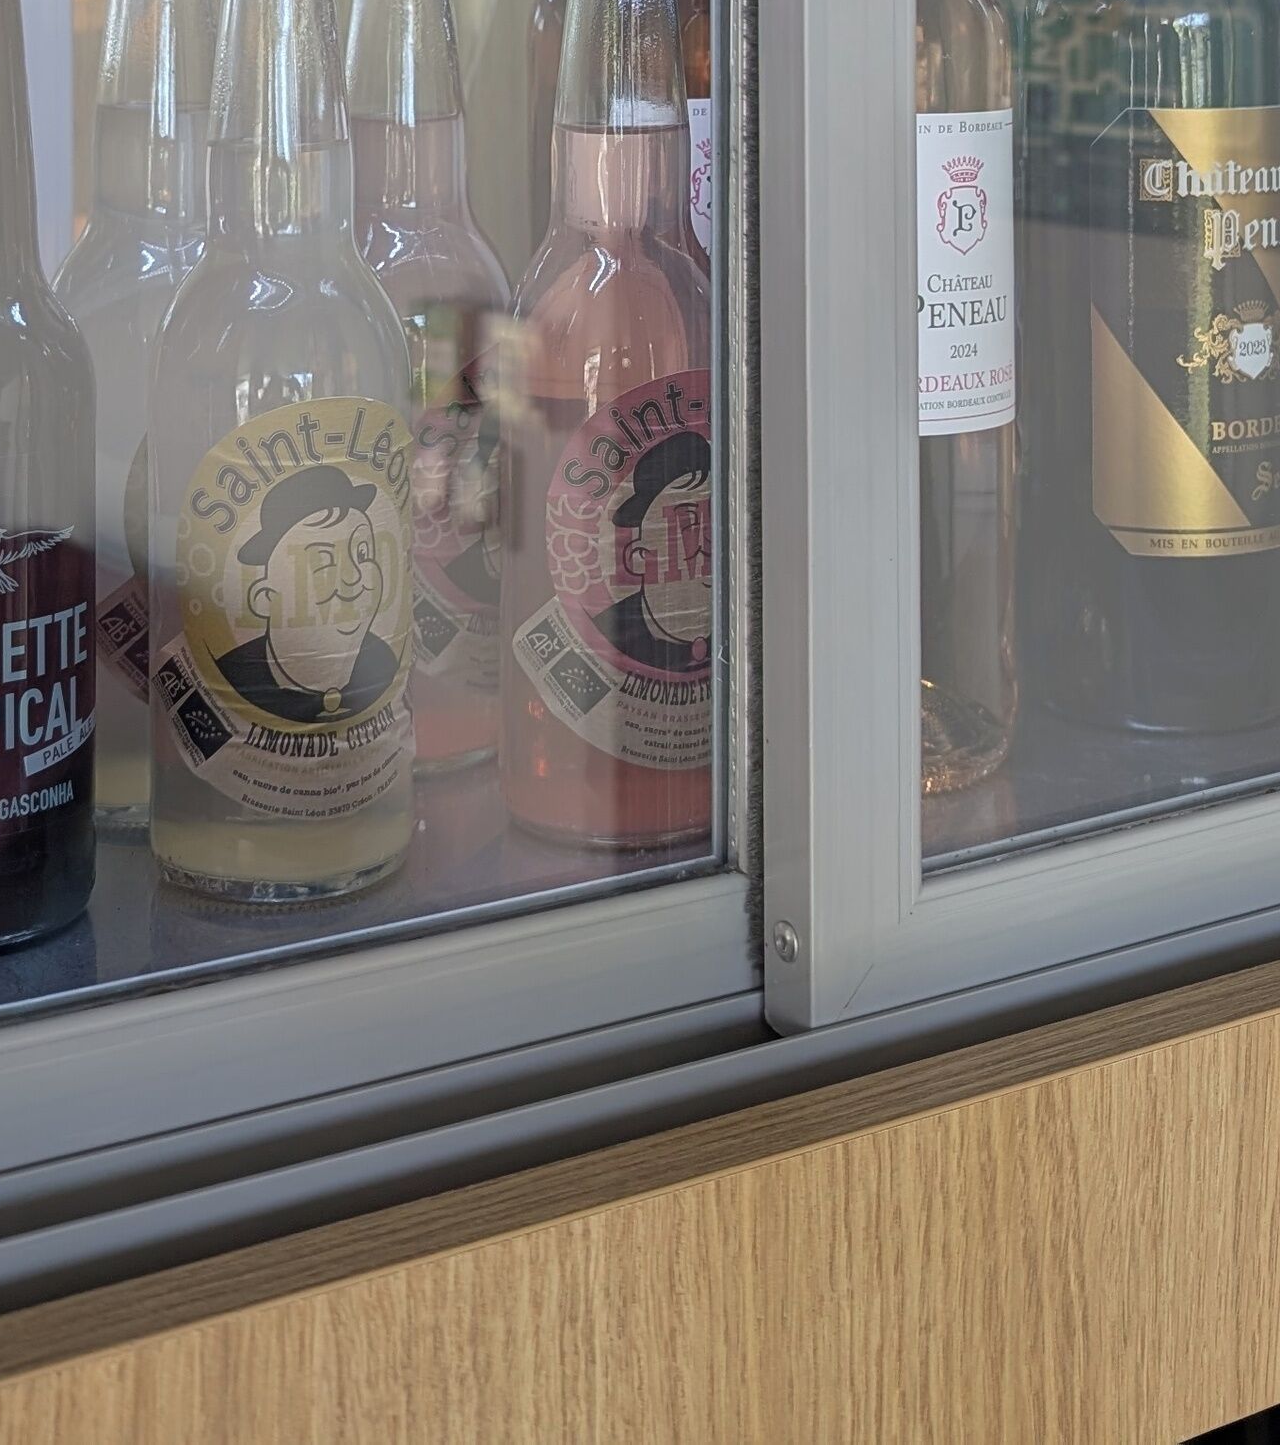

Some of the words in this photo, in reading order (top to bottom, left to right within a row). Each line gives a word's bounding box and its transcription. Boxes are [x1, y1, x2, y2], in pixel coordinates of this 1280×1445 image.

[692, 108, 707, 116] DE
[938, 125, 953, 134] DE
[950, 342, 978, 359] 2024
[1240, 339, 1267, 356] 2023
[947, 397, 985, 409] BORDEAUX
[1149, 538, 1174, 549] MIS
[1181, 538, 1199, 549] EN
[1205, 533, 1265, 548] BOUTEILLE
[619, 670, 697, 706] LIMONADE
[243, 722, 339, 758] LIMONADE
[346, 703, 396, 750] CITRON
[43, 736, 74, 765] PALE
[253, 779, 277, 793] sucre
[279, 786, 291, 795] de
[242, 793, 279, 813] Brasserie
